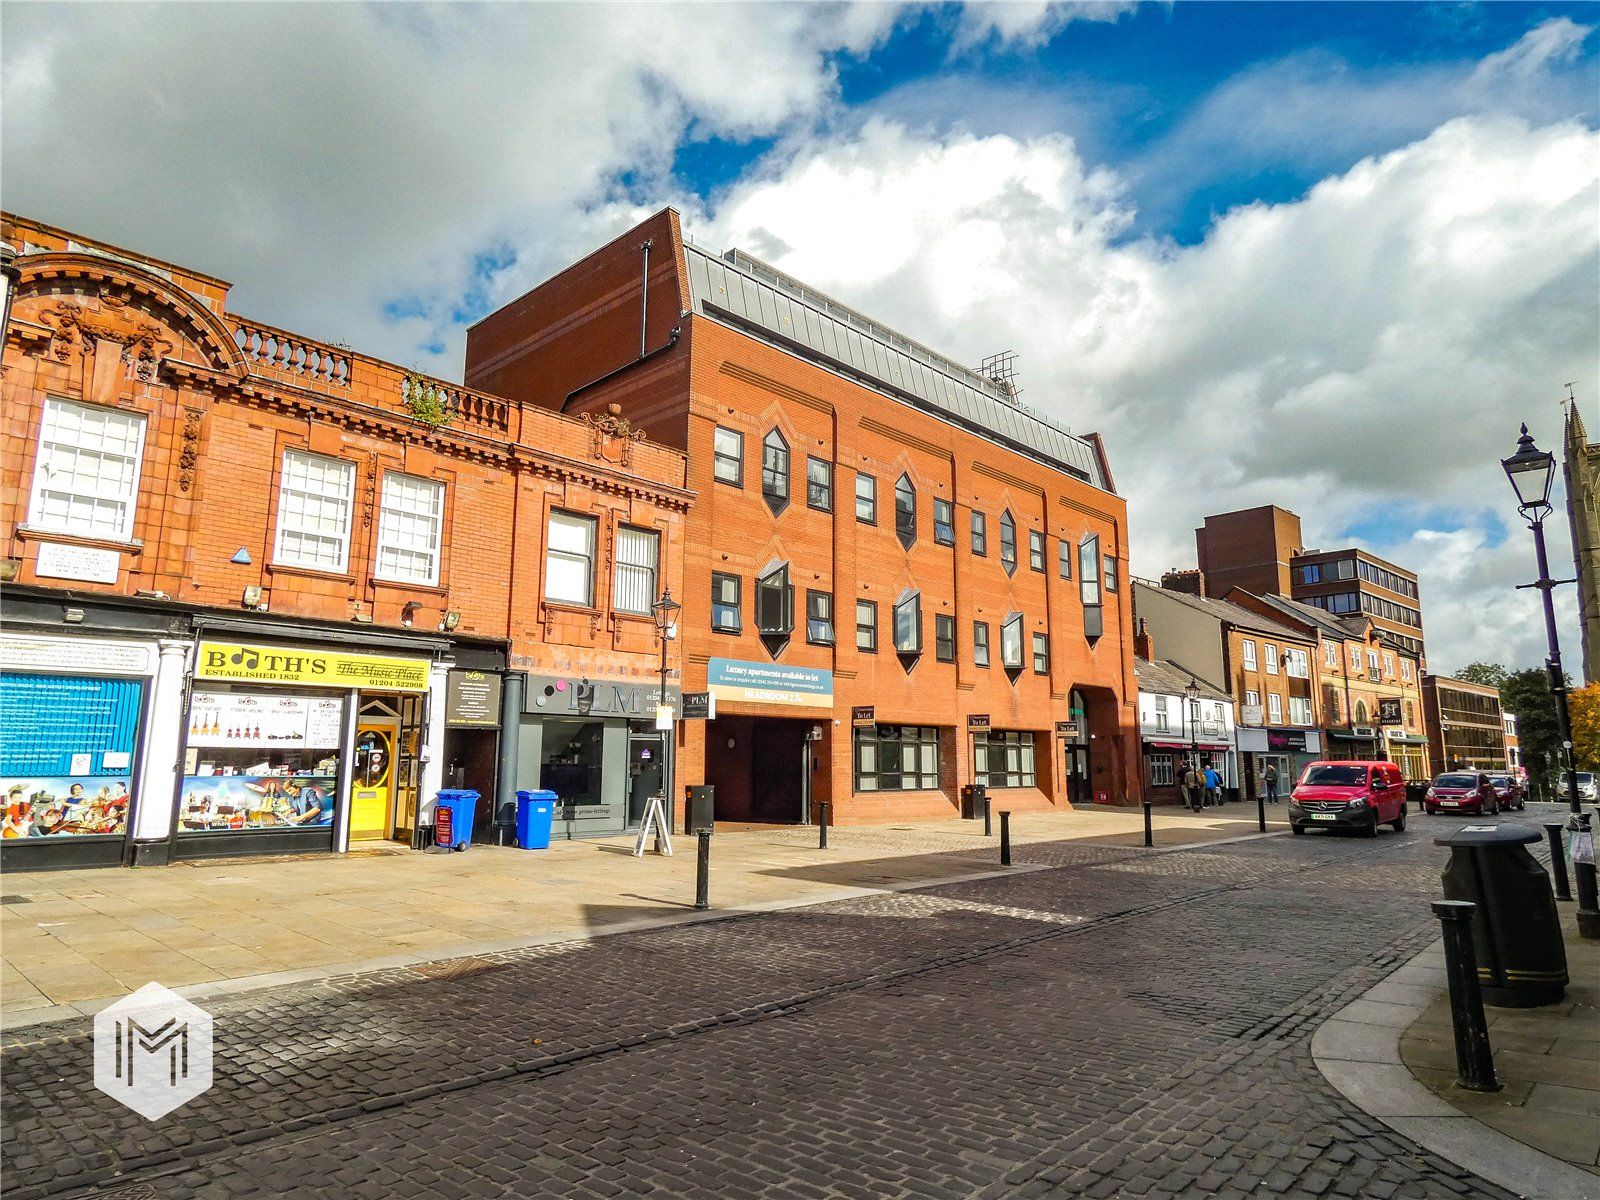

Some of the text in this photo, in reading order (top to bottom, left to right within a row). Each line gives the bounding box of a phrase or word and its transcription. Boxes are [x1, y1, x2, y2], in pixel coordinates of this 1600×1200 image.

[205, 669, 276, 679] ESTABLISHED
[338, 663, 423, 680] The Music Place
[726, 665, 747, 675] Luxury
[748, 669, 781, 678] apartments
[782, 671, 804, 680] available
[568, 682, 641, 714] PLM
[744, 690, 787, 700] HEADROOM
